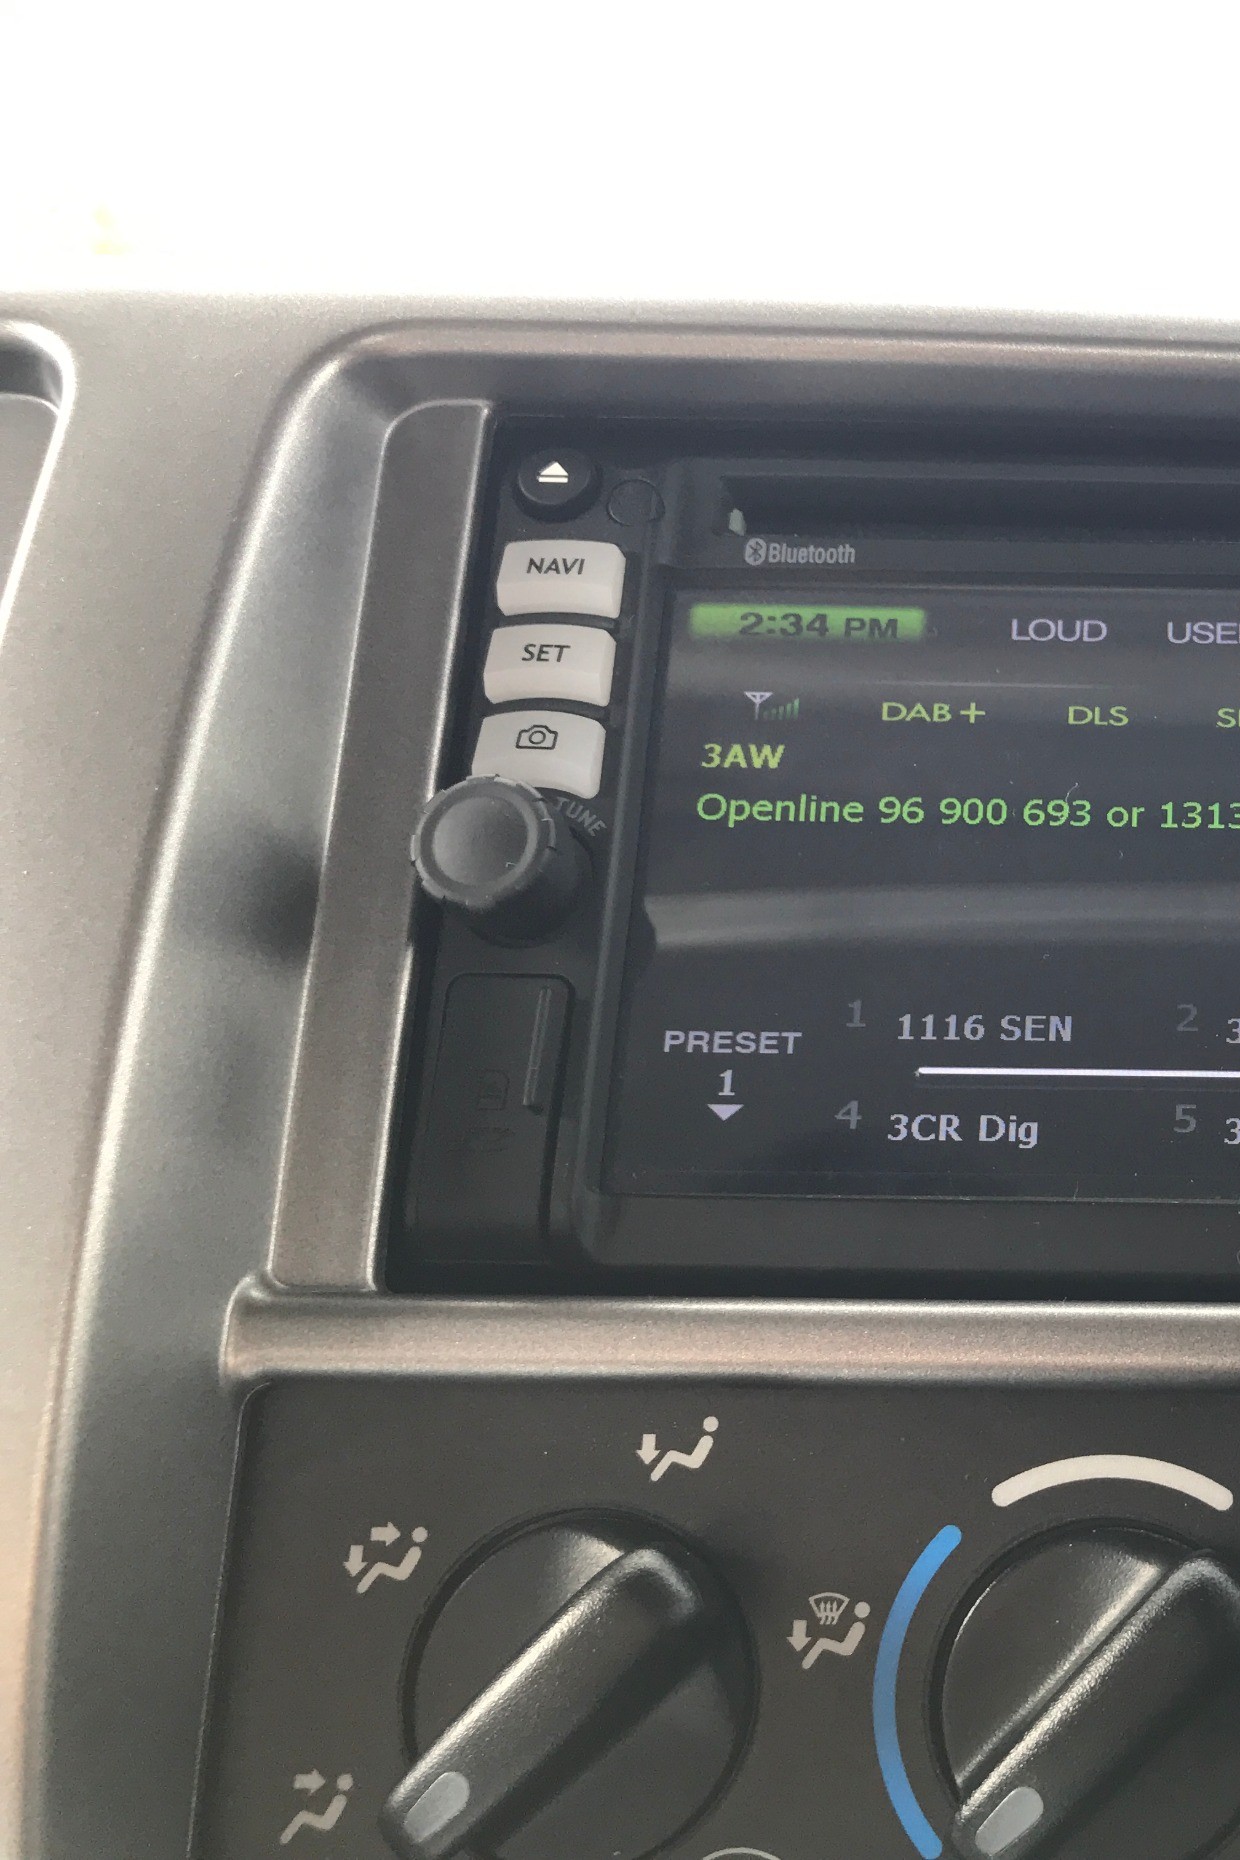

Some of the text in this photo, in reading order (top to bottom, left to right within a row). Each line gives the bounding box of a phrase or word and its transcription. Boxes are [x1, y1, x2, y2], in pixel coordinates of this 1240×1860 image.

[526, 557, 586, 576] NAVI
[768, 541, 857, 566] Bluetooth
[739, 612, 899, 639] 2:34 PM
[1010, 618, 1108, 643] LOUD
[521, 644, 571, 662] SET
[1067, 705, 1130, 727] DLS
[701, 743, 785, 770] 3AW
[555, 796, 607, 837] TUNE
[697, 794, 864, 827] Openline
[879, 797, 924, 823] 96
[939, 798, 1007, 826] 900
[1022, 799, 1092, 827] 693
[1106, 806, 1145, 828] or
[845, 1000, 867, 1029] 1
[898, 1014, 1074, 1043] 1116 SEN
[1174, 1003, 1199, 1033] 2
[663, 1029, 802, 1056] PRESET
[716, 1069, 737, 1097] 1
[834, 1101, 863, 1130] 4
[1173, 1104, 1198, 1134] 5
[886, 1113, 1040, 1149] 3CR Dig
